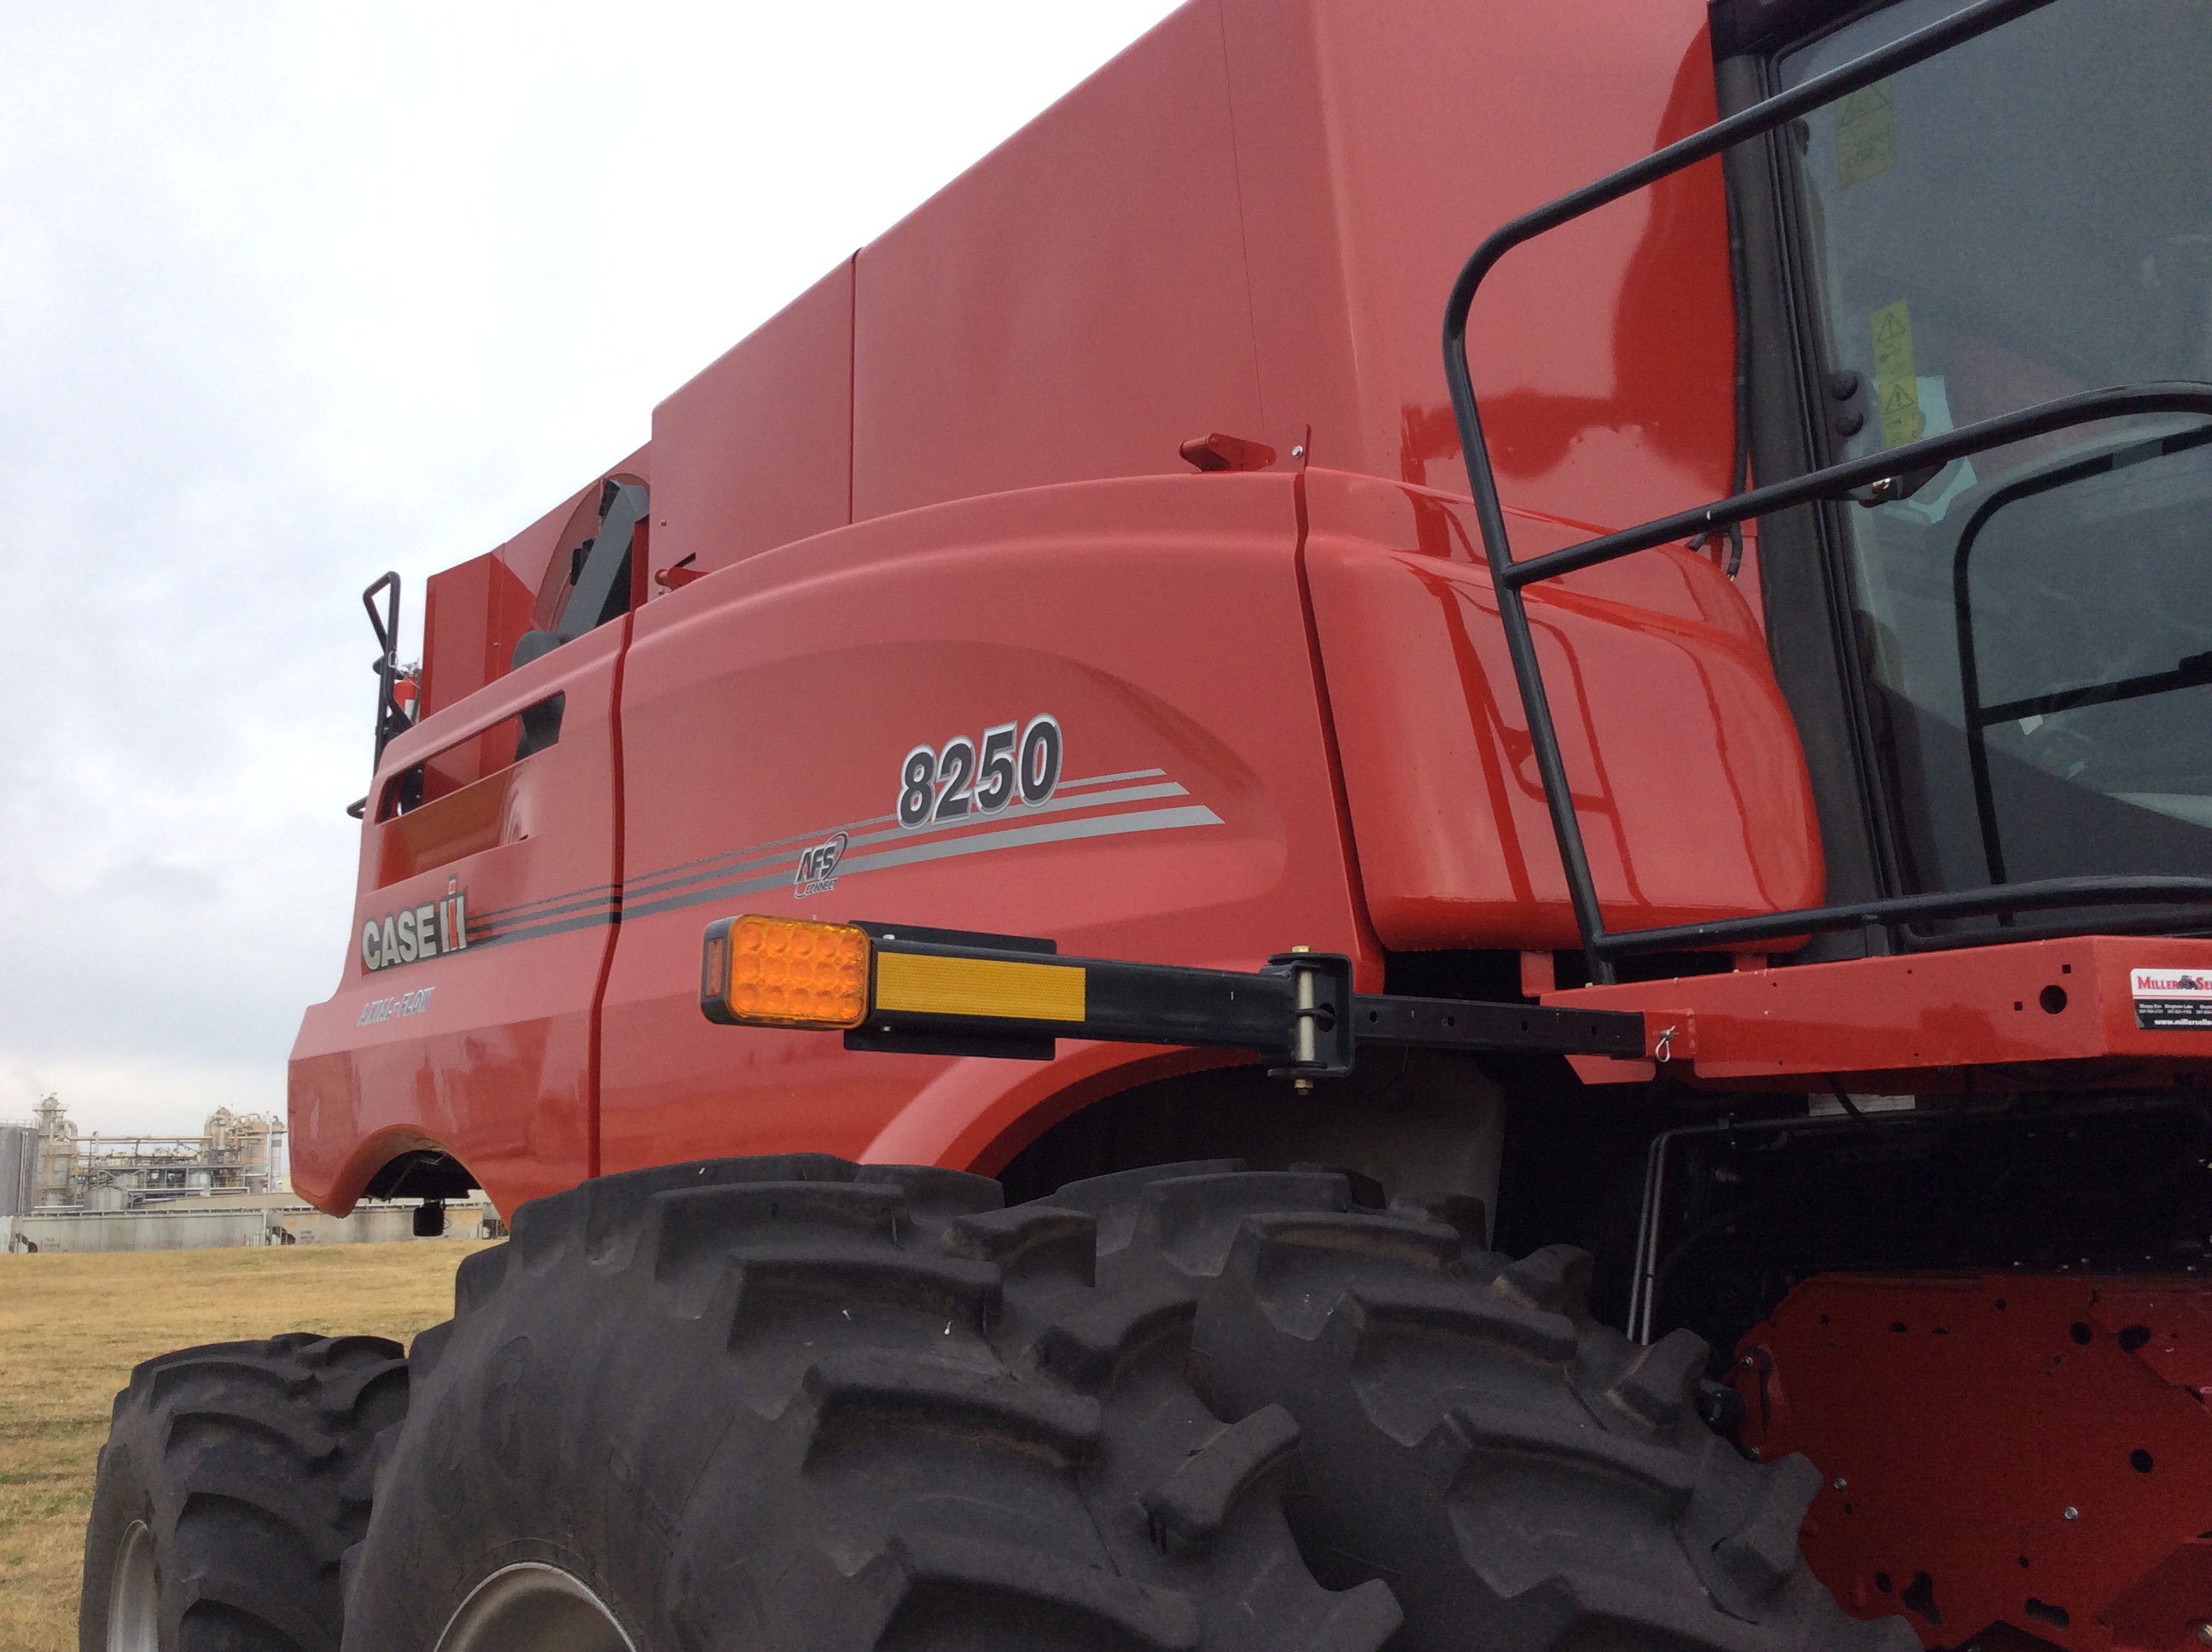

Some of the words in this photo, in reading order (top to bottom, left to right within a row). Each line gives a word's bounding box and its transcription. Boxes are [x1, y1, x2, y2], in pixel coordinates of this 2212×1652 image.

[898, 713, 1062, 830] 8250
[794, 841, 837, 884] AFS
[805, 878, 838, 895] CONNECT
[362, 900, 437, 971] CASE
